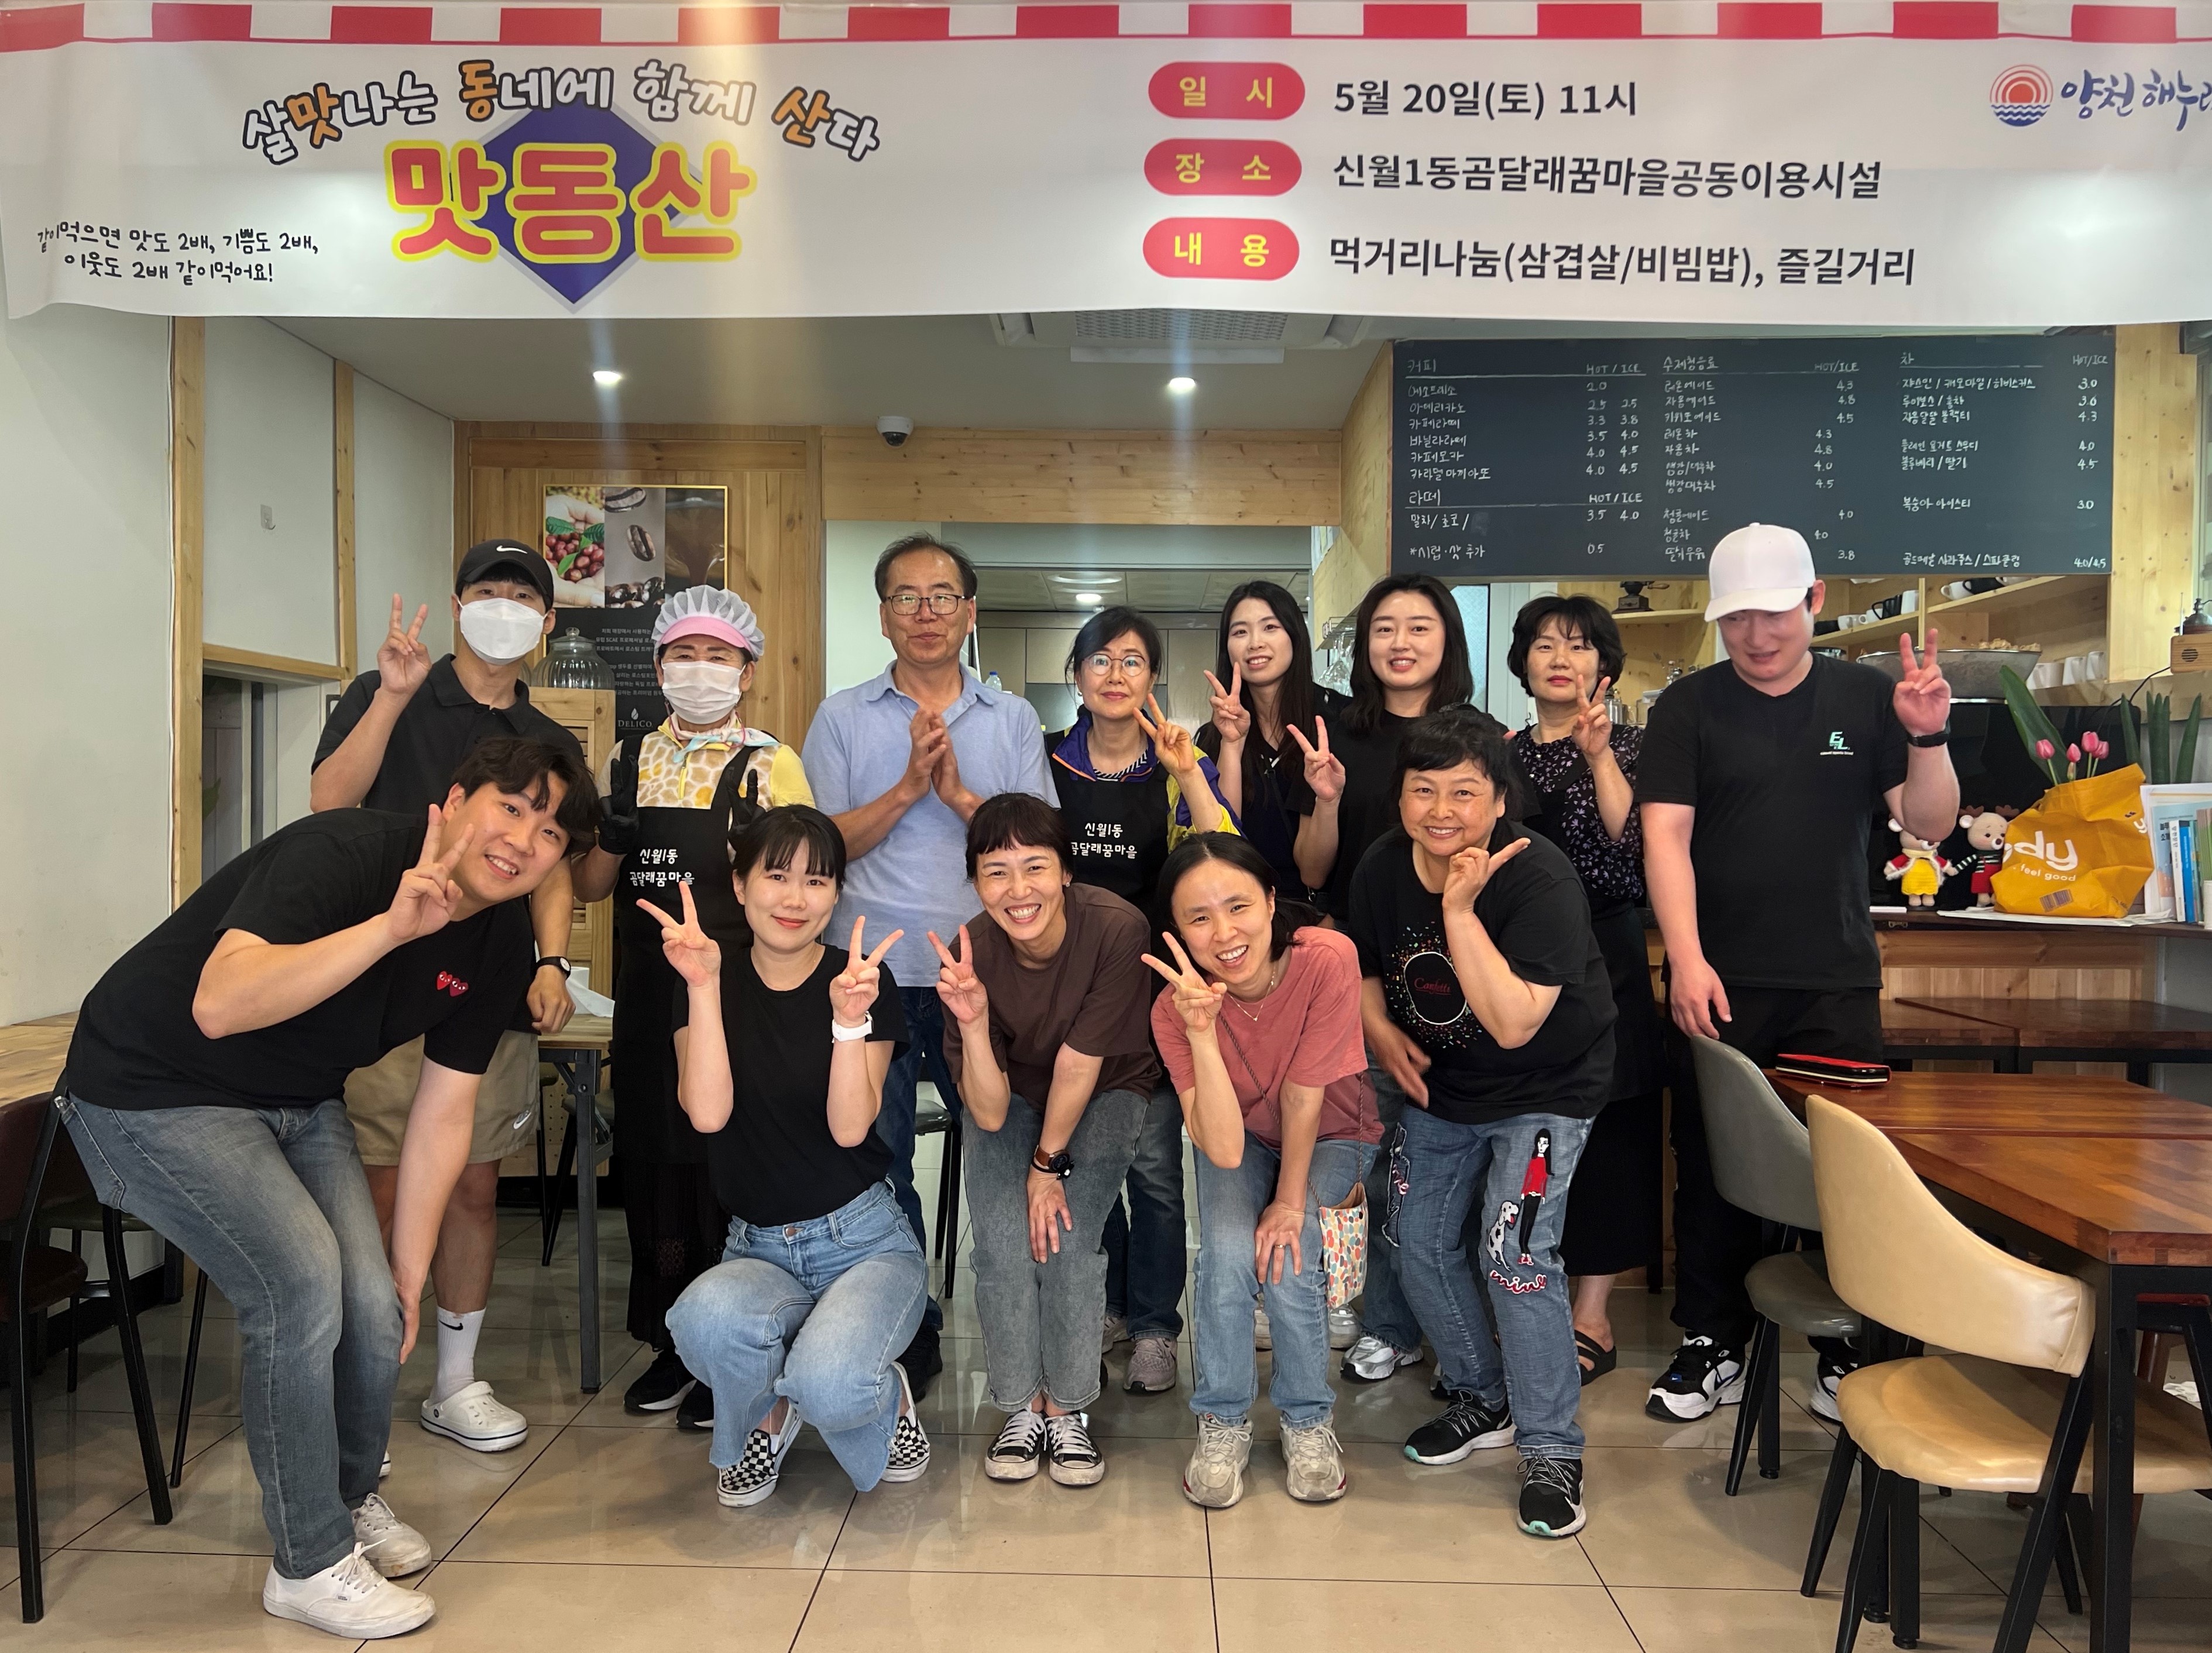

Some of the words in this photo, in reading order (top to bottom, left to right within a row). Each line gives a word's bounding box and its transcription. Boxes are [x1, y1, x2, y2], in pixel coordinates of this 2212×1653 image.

[1334, 80, 1390, 115] 5월
[1403, 81, 1545, 121] 20일(토)
[1559, 81, 1636, 116] 11시
[2060, 68, 2135, 119] 양천
[242, 71, 438, 166] 살맛나는
[458, 59, 614, 122] 동네에
[634, 59, 757, 126] 함께
[772, 85, 880, 161] 산다
[1334, 154, 1881, 199] 신월1동곰달래꿈마을공동이용시설
[384, 140, 758, 263] 맛동산
[129, 229, 170, 253] 맛도
[178, 232, 216, 253] 2배,
[222, 228, 272, 255] 기쁨도
[279, 232, 320, 253] 2배,
[64, 251, 122, 279] 이웃도
[132, 262, 169, 280] 2배
[176, 261, 273, 286] 같이먹어요!
[1330, 237, 1764, 287] 먹거리나눔(삼겹살/비빔밥),
[1777, 247, 1915, 286] 즐길거리
[1663, 355, 1719, 372] 수제청음료
[1900, 352, 1915, 365] 차
[1407, 359, 1436, 373] 커피
[1836, 380, 1853, 392] 4.3
[2078, 378, 2097, 390] 3.0
[1665, 395, 1716, 408] 자몽에이드
[1838, 394, 1855, 405] 4.8
[1587, 415, 1606, 426] 3.3
[1620, 414, 1639, 425] 3.8
[1836, 413, 1854, 424] 4.5
[1587, 431, 1608, 442] 3.5
[1620, 429, 1639, 441] 4.0
[1816, 429, 1832, 439] 4.3
[1410, 451, 1464, 463] 카페모카
[1586, 446, 1605, 458] 4.0
[1620, 445, 1639, 457] 4.5
[1814, 444, 1833, 455] 4.8
[1586, 464, 1605, 475] 4.0
[1619, 463, 1638, 474] 4.5
[1814, 461, 1833, 472] 4.0
[1815, 479, 1835, 490] 4.5
[1409, 489, 1441, 506] 라떼
[1587, 510, 1607, 521] 3.5
[1620, 510, 1640, 521] 4.0
[1466, 544, 1485, 559] 추가
[1838, 549, 1855, 560] 3.8
[2021, 863, 2041, 877] feel
[2045, 872, 2076, 882] good
